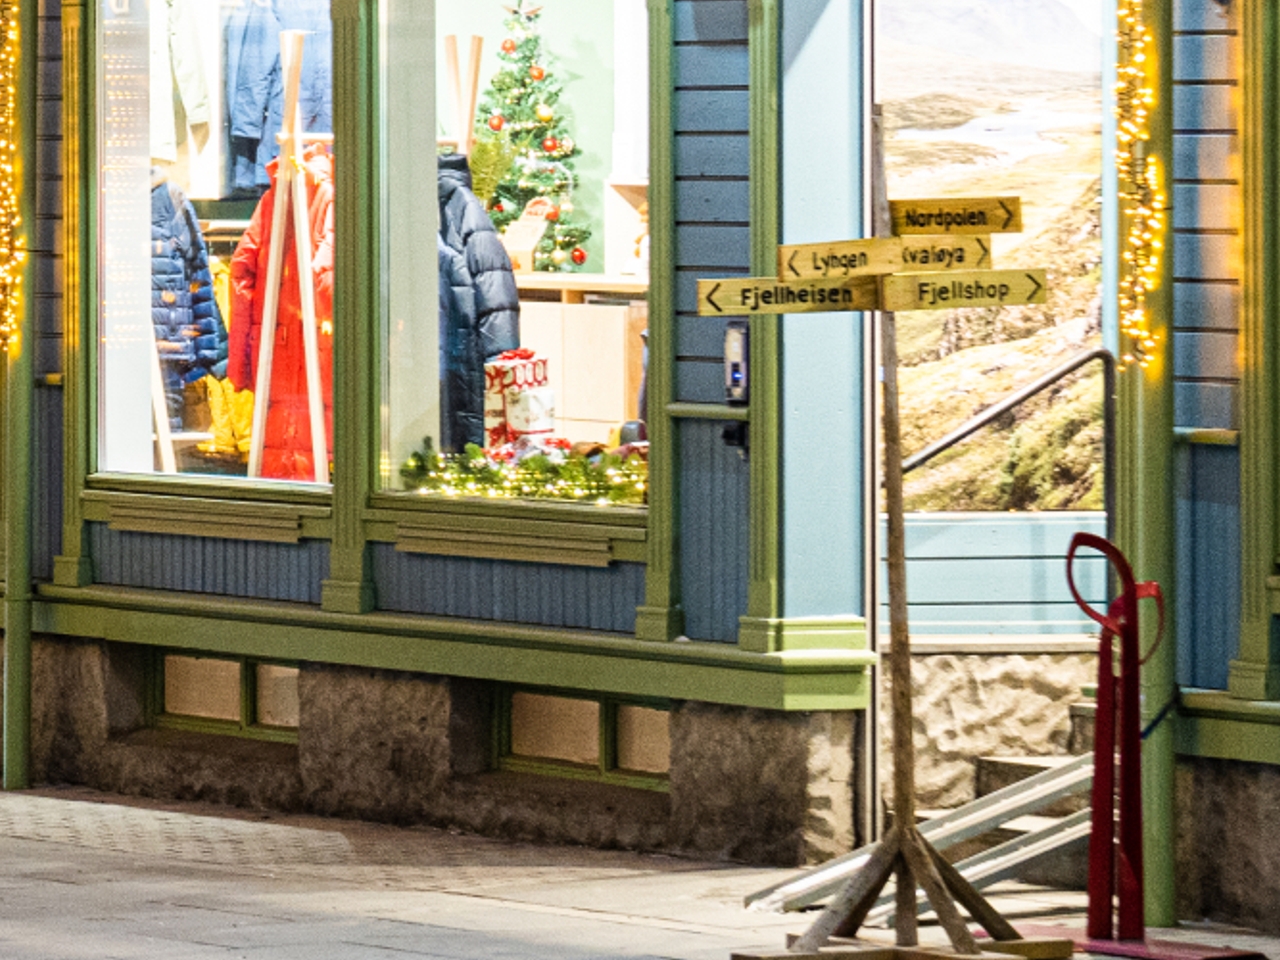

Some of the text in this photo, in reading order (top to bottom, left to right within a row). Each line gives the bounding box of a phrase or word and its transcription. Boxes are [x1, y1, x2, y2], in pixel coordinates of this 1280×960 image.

[905, 208, 988, 231] Nordpolen
[812, 250, 869, 278] Lyngen
[740, 285, 853, 310] Fjellheisen
[918, 281, 1010, 305] Fjellshop
